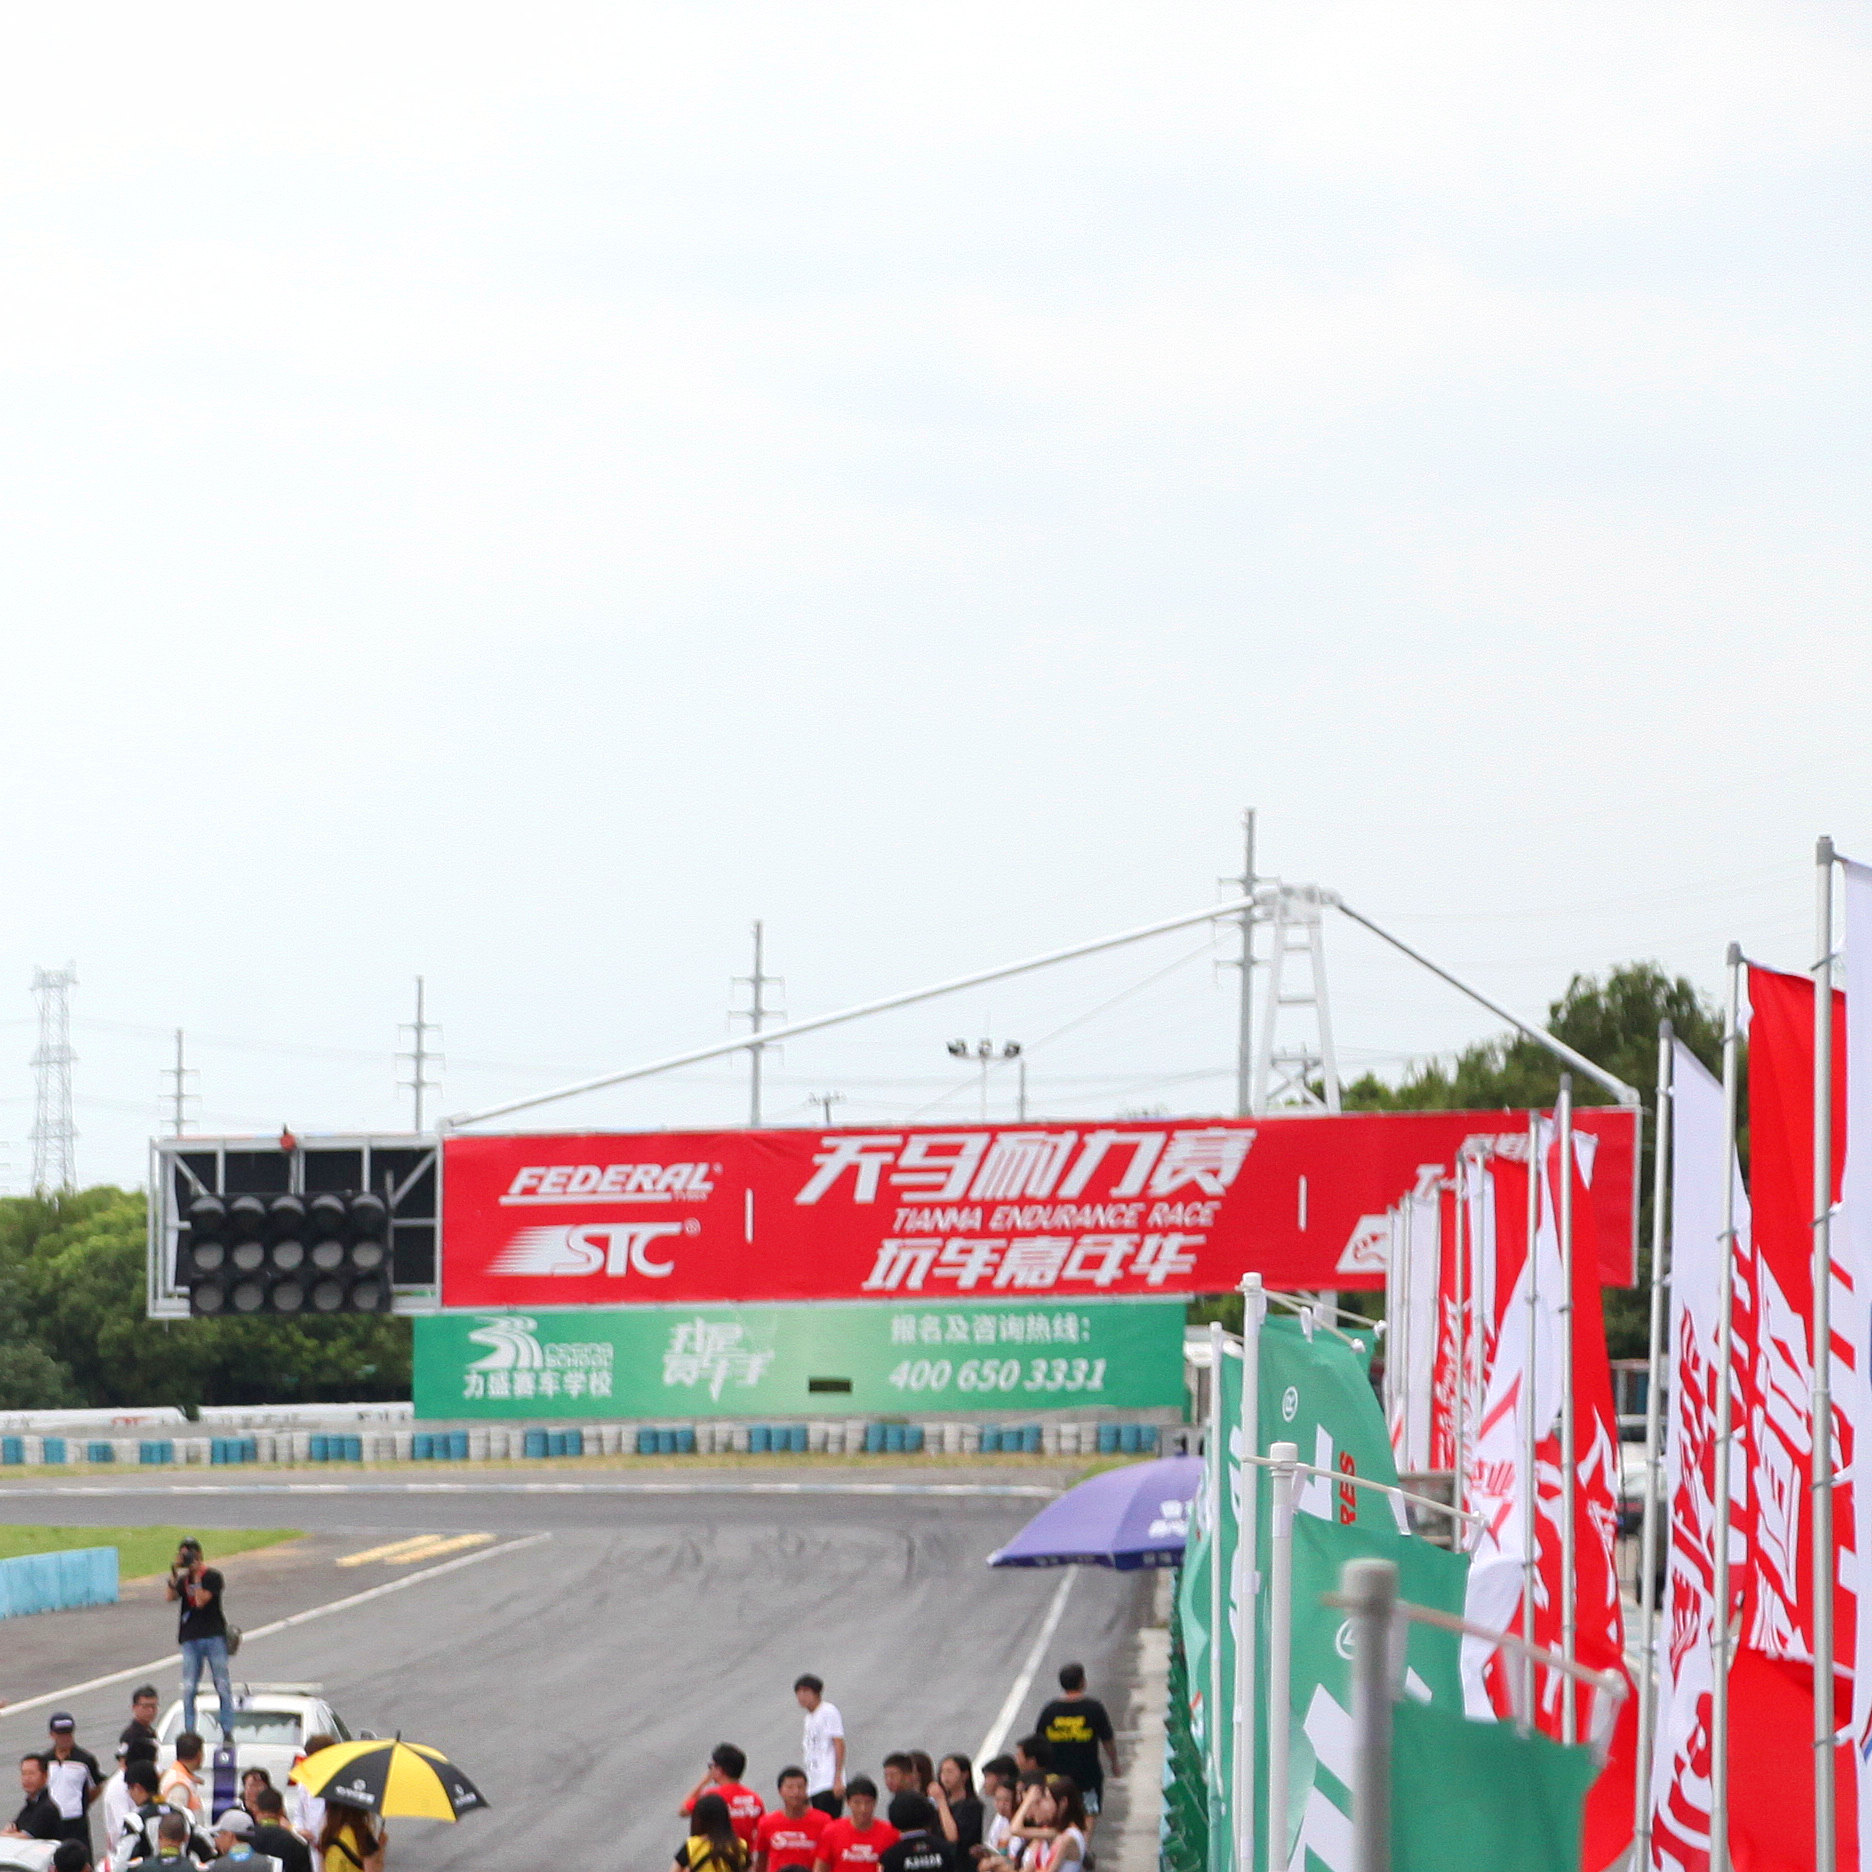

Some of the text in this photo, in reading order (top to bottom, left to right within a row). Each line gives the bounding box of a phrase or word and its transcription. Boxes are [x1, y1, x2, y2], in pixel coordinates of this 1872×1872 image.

[508, 1162, 714, 1195] FEDERAL
[795, 1128, 1257, 1205] 天马耐力赛
[893, 1201, 1221, 1232] TIANMA ENDURANCE RACE
[551, 1221, 684, 1278] STC
[862, 1233, 1207, 1291] 玩车嘉年华
[462, 1371, 614, 1400] 力盛赛车学校
[889, 1358, 1108, 1392] 400 650 3331
